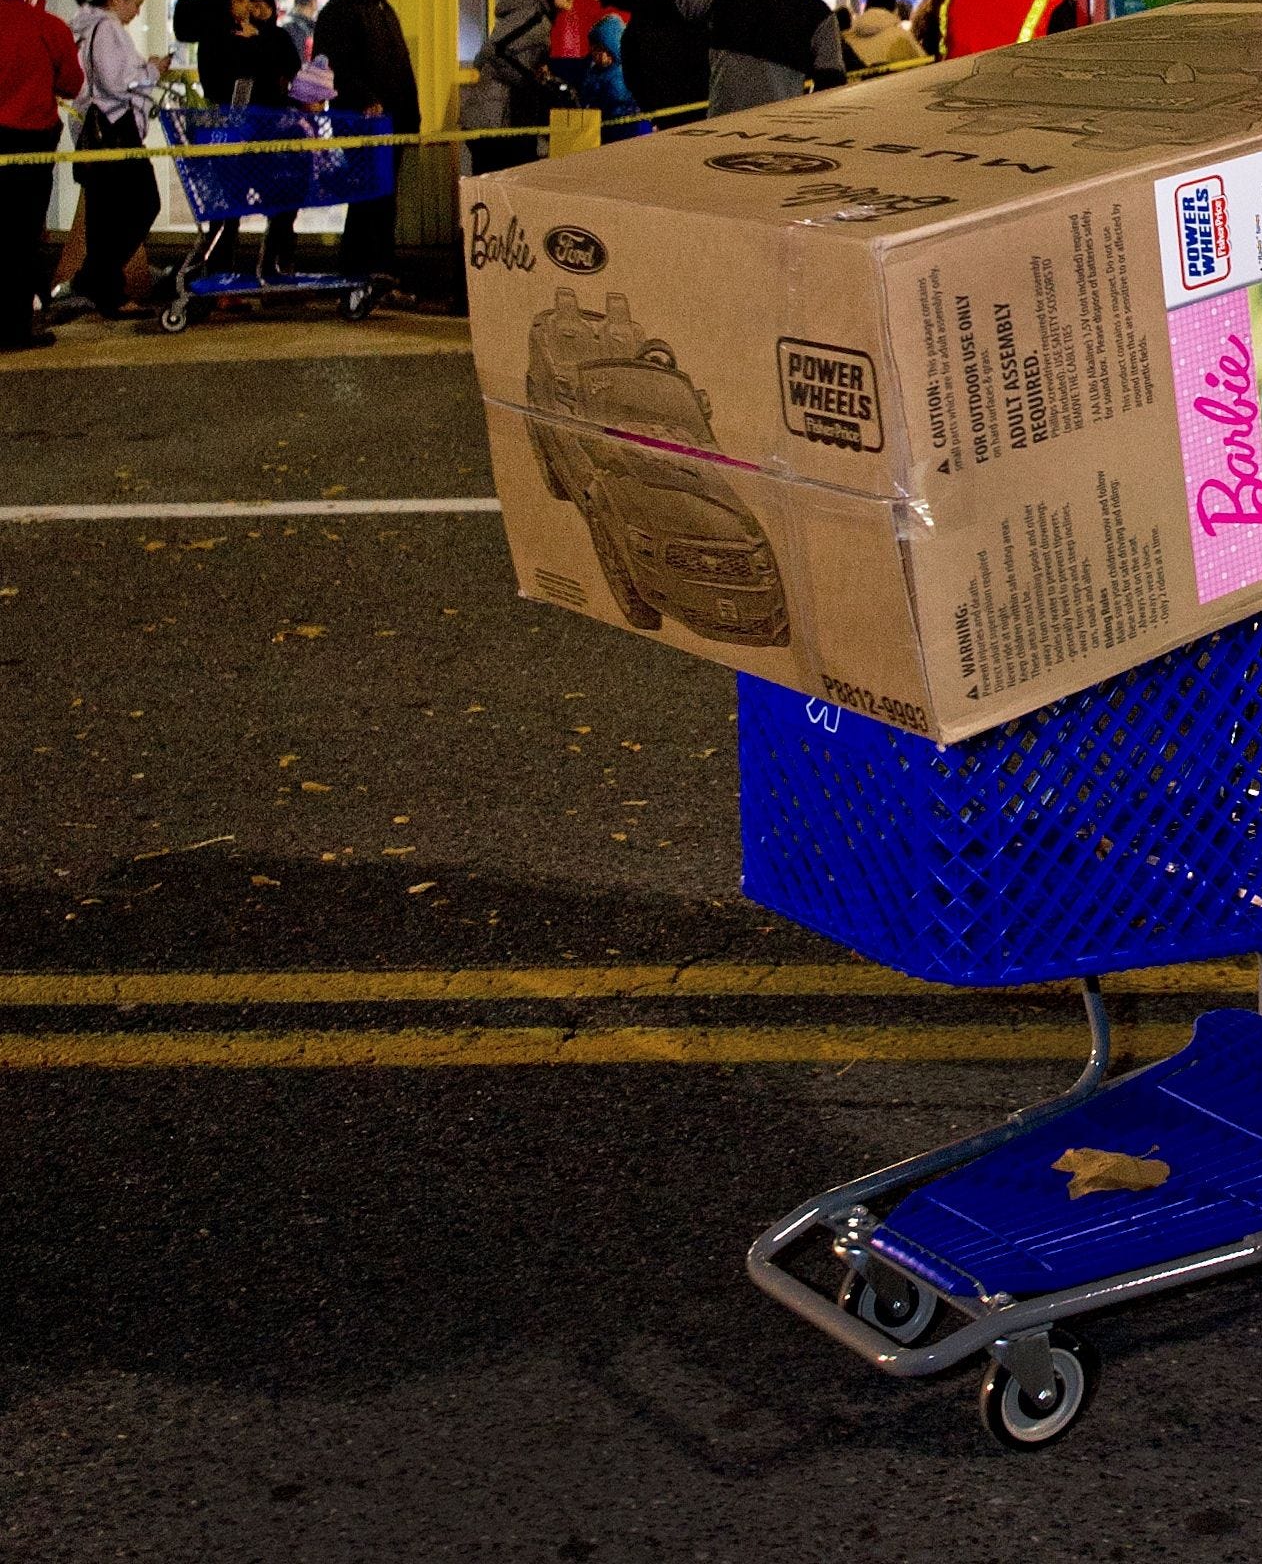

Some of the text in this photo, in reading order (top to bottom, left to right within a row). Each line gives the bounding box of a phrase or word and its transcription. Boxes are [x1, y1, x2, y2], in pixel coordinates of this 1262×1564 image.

[1110, 203, 1122, 215] by
[470, 202, 537, 272] Barbie
[1068, 213, 1082, 252] required
[1111, 215, 1124, 251] affected
[1182, 196, 1201, 276] POWER
[1195, 188, 1214, 274] WHEELS
[1085, 237, 1097, 278] batteries
[1103, 243, 1114, 259] not
[1105, 260, 1115, 274] Do
[1073, 253, 1086, 296] included)
[1078, 296, 1090, 316] (not
[1091, 289, 1103, 323] dispose
[1119, 276, 1131, 314] sensitive
[917, 277, 938, 378] This package contains
[931, 290, 945, 333] assembly
[1030, 255, 1060, 438] Phillips screwdriver required for assembly
[1041, 257, 1073, 434] (not included). USE SAFETY SCISSORS TO
[1095, 324, 1105, 354] Please
[1113, 320, 1124, 357] contains
[788, 352, 864, 391] POWER
[940, 360, 951, 375] for
[1083, 338, 1096, 378] Alkaline)
[955, 295, 989, 463] FOR OUTDOOR USE ONLY
[994, 303, 1027, 449] ADULT ASSEMBLY
[1061, 323, 1083, 430] REMOVE THE CABLE TIES
[1099, 377, 1112, 404] sound
[1117, 358, 1131, 393] product
[1141, 362, 1154, 404] magnetic
[788, 379, 872, 420] WHEELS
[943, 391, 956, 420] which
[984, 385, 997, 422] surfaces
[1023, 350, 1047, 443] REQUIRED.
[1090, 401, 1101, 415] AA
[1121, 393, 1131, 413] This
[1130, 376, 1143, 408] around
[926, 380, 946, 448] CAUTION:
[1103, 405, 1114, 419] for
[948, 420, 962, 445] parts
[988, 422, 1000, 445] hard
[950, 445, 964, 471] small
[992, 445, 1002, 458] on
[1003, 544, 1014, 572] riding
[1153, 554, 1163, 565] at
[1005, 573, 1017, 592] safe
[1132, 571, 1142, 585] on
[1133, 584, 1144, 597] sit
[1155, 565, 1166, 591] riders
[983, 588, 997, 639] supervision
[1008, 592, 1021, 622] within
[1098, 587, 1114, 649] Riding Rules
[1136, 597, 1148, 628] Always
[1158, 599, 1169, 620] Only
[955, 603, 975, 677] WARNING:
[1000, 630, 1011, 641] at
[1001, 641, 1014, 660] ride
[1013, 622, 1026, 658] children
[992, 664, 1004, 693] Direct
[1005, 661, 1016, 688] Never
[1018, 659, 1029, 683] Keep
